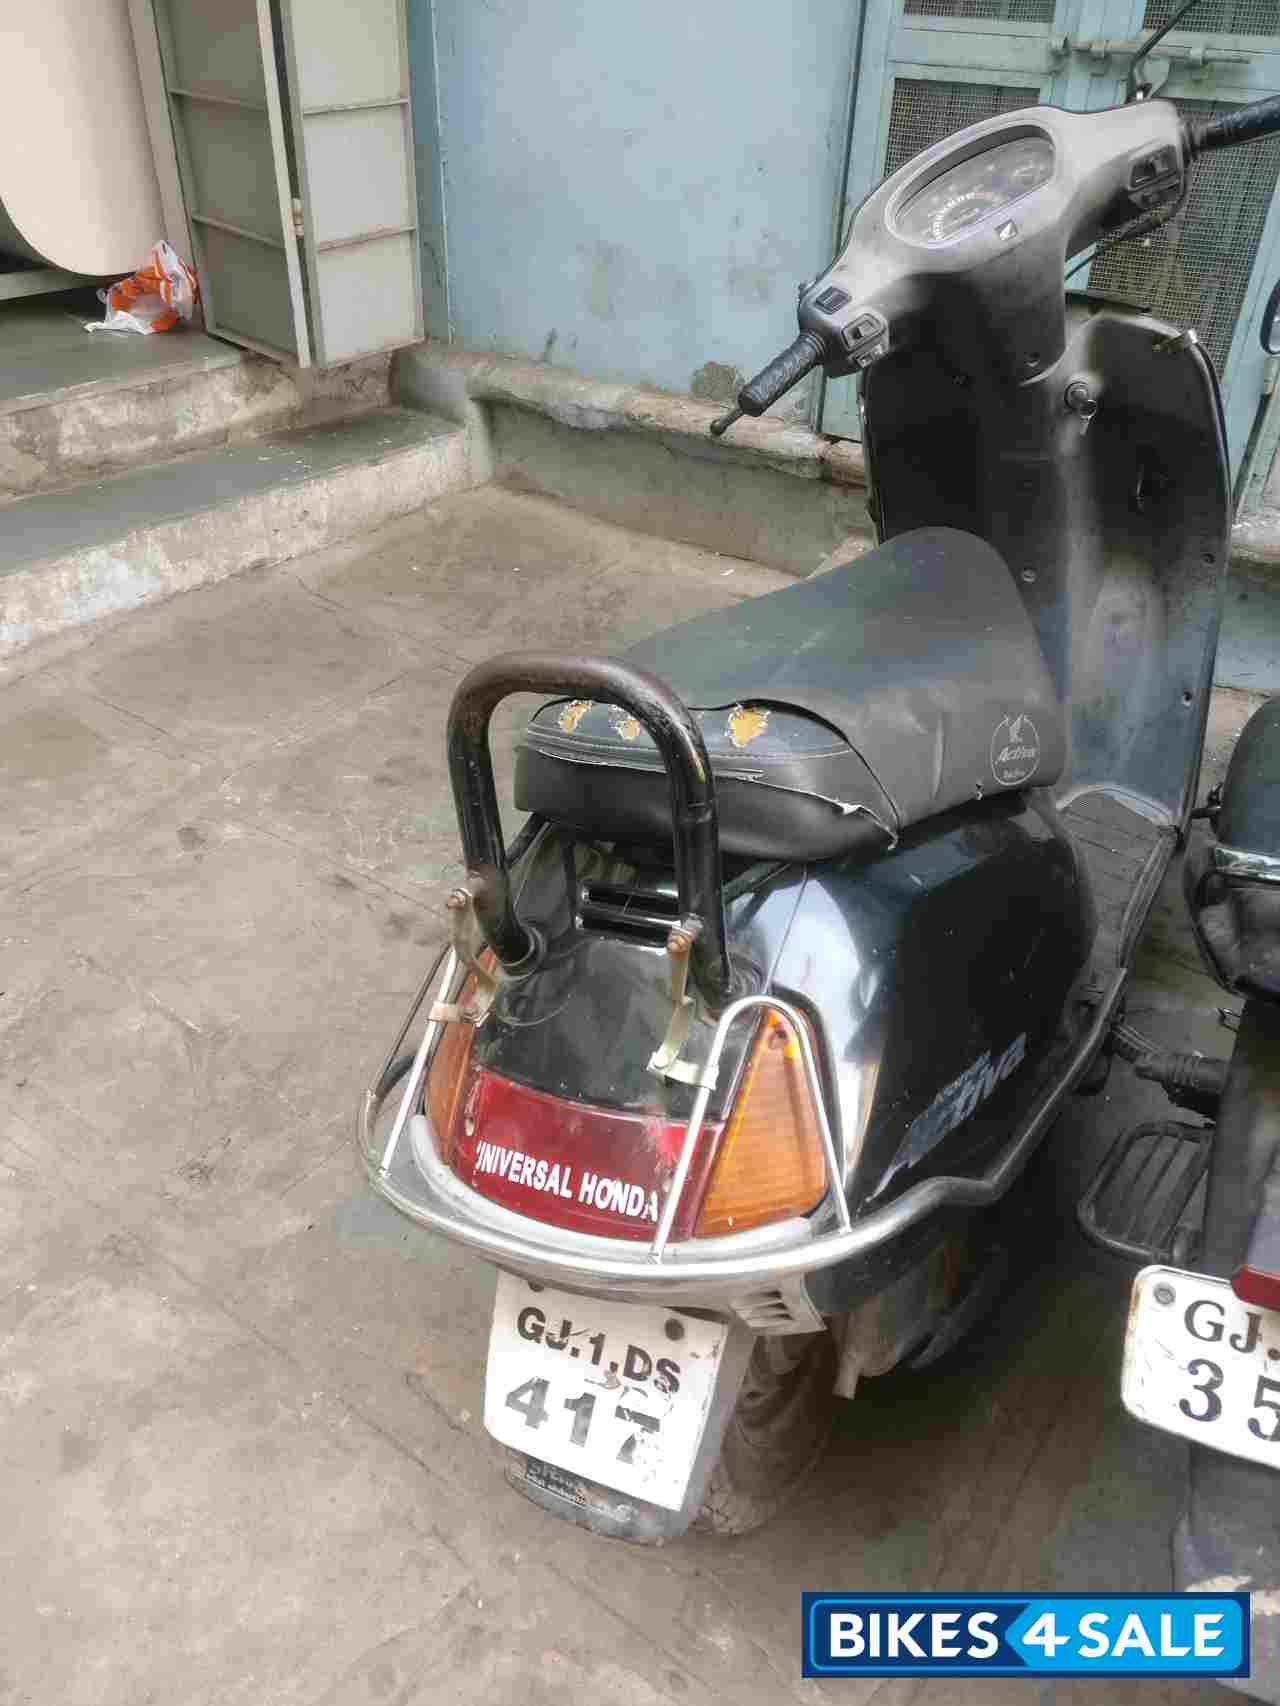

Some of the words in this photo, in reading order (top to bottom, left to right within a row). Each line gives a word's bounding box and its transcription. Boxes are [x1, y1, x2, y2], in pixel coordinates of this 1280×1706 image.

[476, 1140, 573, 1199] UNIVERSAL
[579, 1171, 659, 1222] HONDA
[504, 1375, 661, 1465] 417
